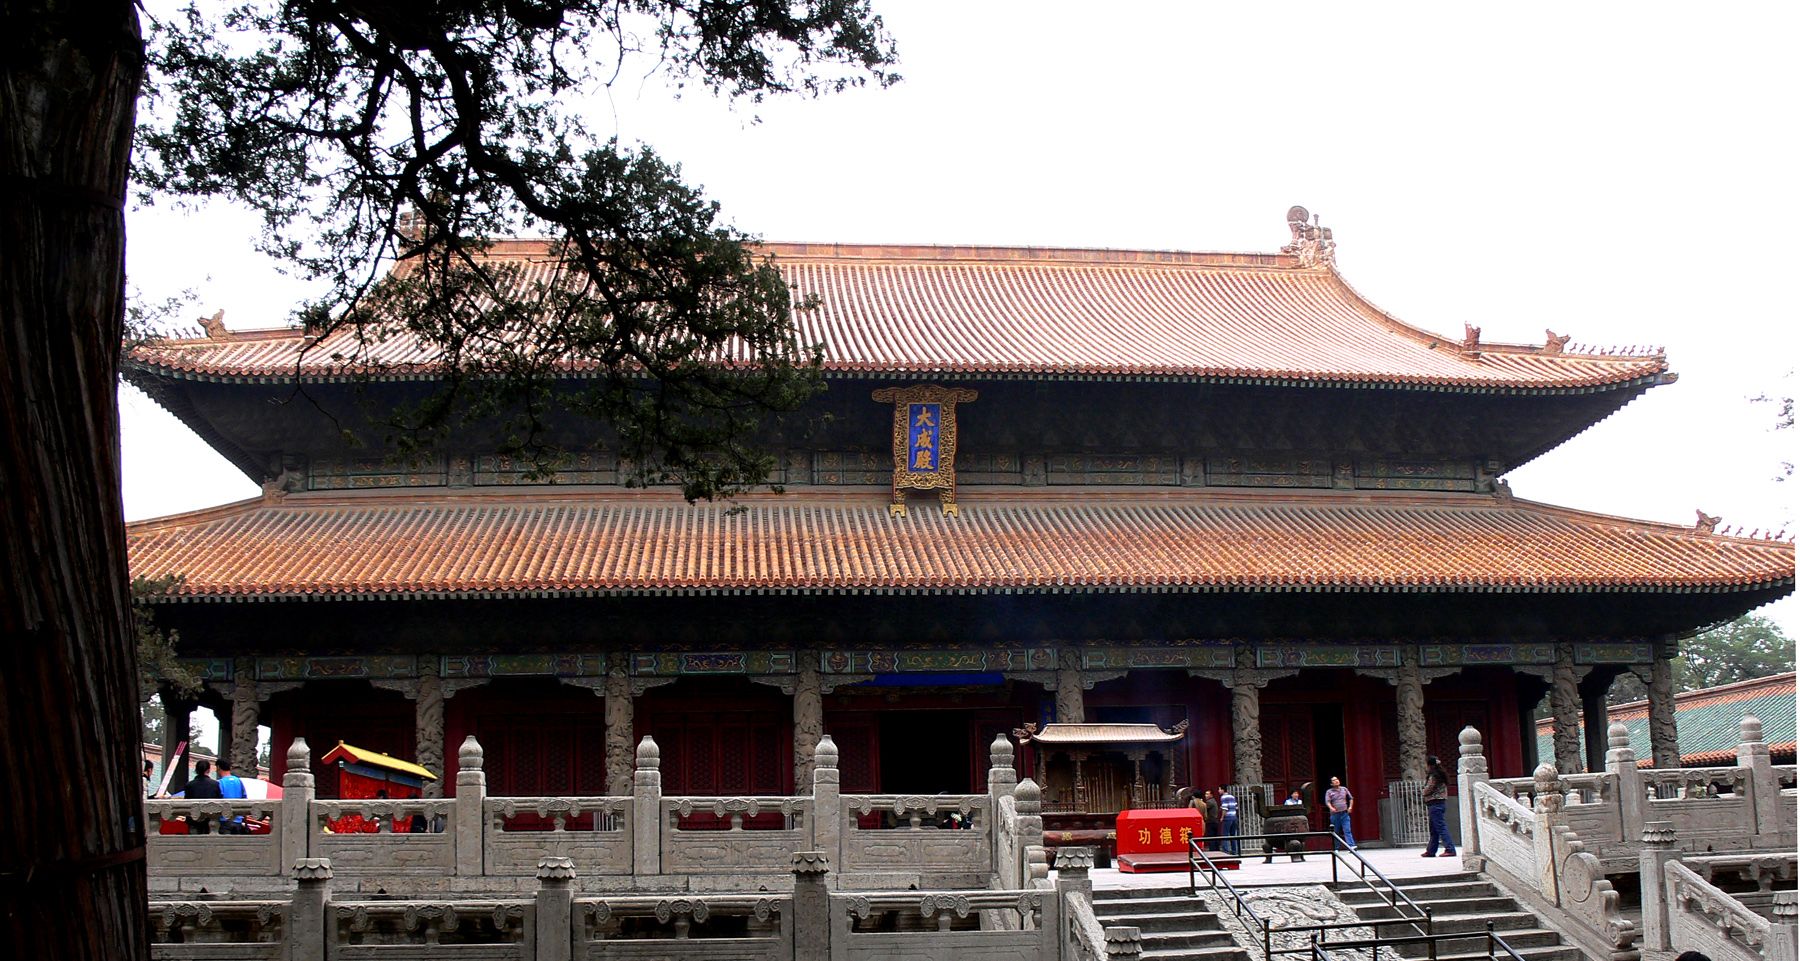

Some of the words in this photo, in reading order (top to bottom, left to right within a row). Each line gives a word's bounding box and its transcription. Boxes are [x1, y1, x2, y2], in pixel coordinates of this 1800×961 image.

[913, 406, 935, 470] 大成殿
[1138, 827, 1191, 845] 功德箱
